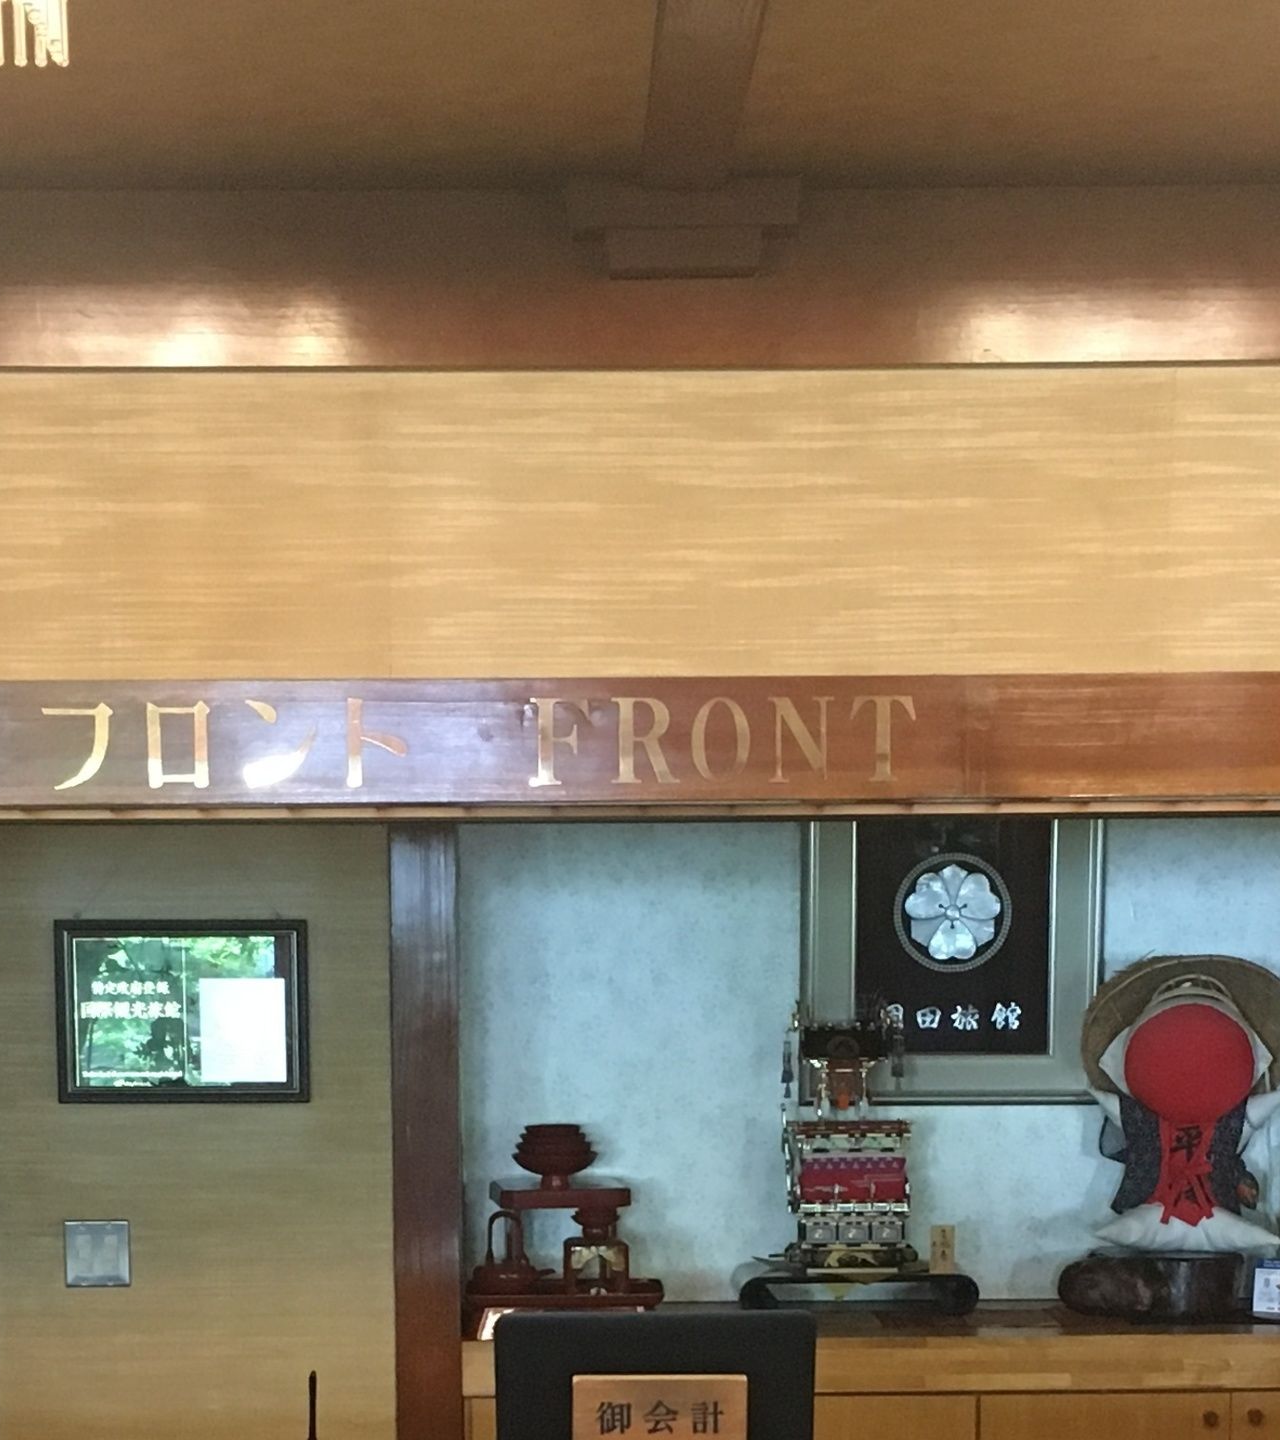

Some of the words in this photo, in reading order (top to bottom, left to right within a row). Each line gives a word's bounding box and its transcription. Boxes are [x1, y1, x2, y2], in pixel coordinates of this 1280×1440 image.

[40, 698, 407, 790] フロント
[528, 695, 918, 787] FRONT
[596, 1400, 724, 1435] 御会計
